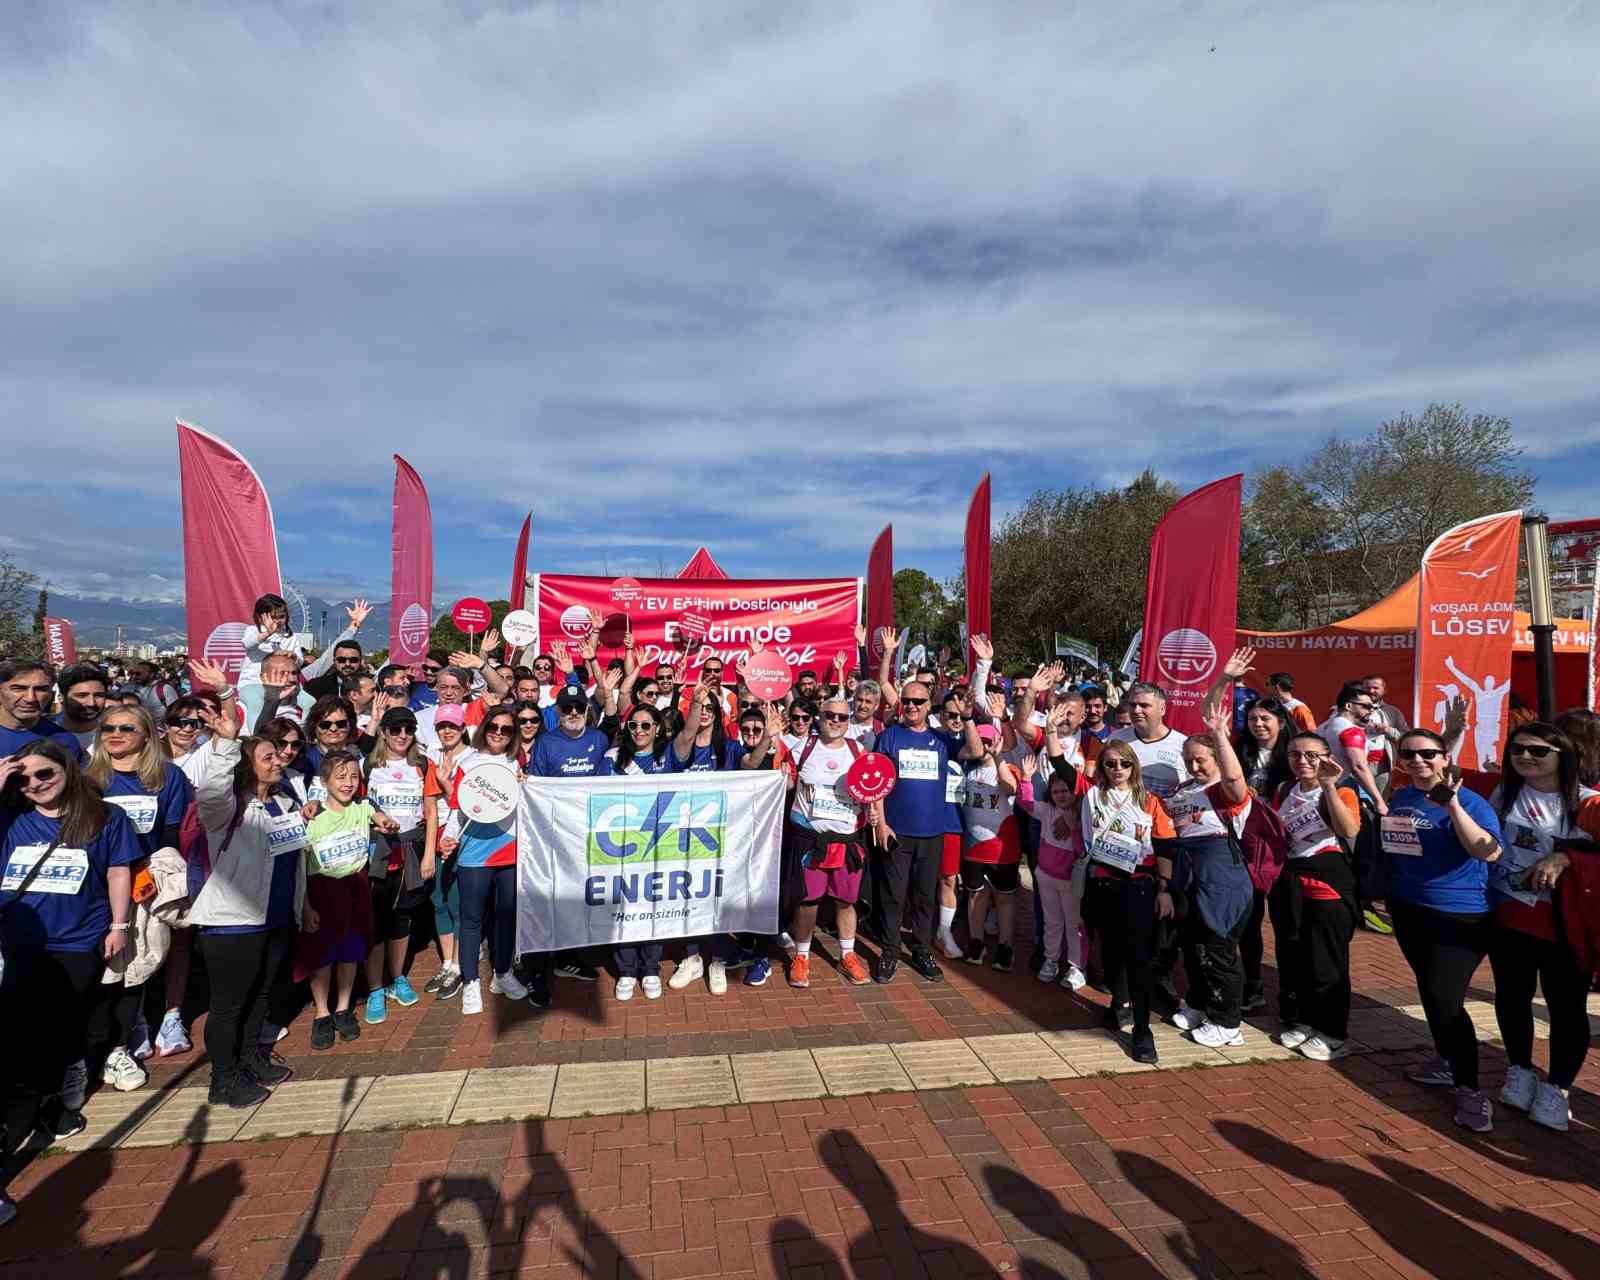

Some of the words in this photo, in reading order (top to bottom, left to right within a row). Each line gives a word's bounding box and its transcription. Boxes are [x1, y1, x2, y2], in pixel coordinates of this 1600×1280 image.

[730, 598, 818, 613] Dostlarıyla
[1430, 603, 1479, 615] KOŞAR
[564, 623, 591, 631] TEV
[664, 621, 792, 643] Etimde
[1431, 617, 1510, 636] LÖSEV
[1302, 635, 1359, 649] HAYAT
[1163, 657, 1209, 672] TEV
